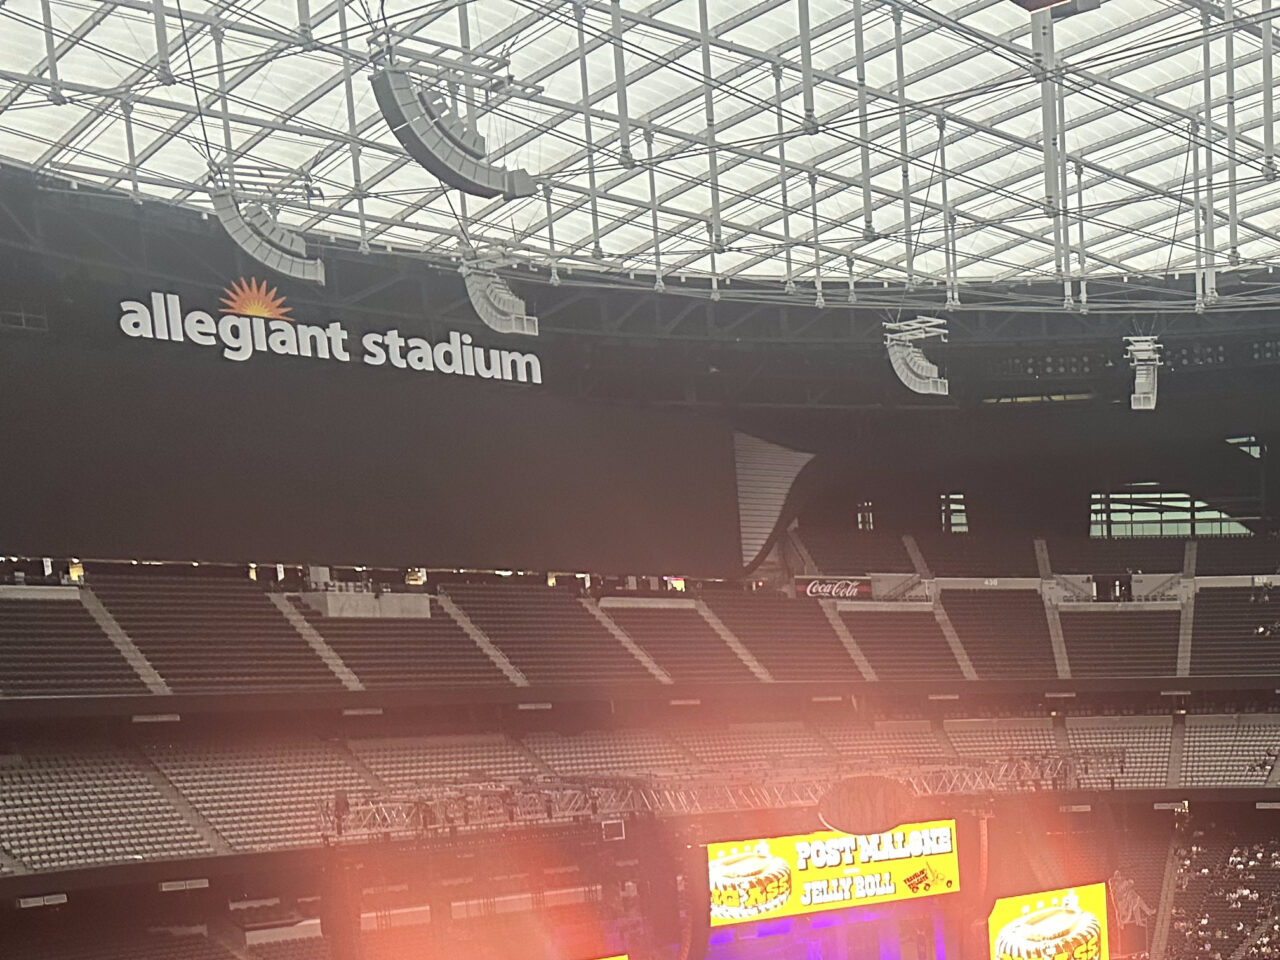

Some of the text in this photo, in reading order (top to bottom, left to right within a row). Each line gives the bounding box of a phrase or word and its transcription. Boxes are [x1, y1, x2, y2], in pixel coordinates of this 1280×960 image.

[119, 291, 543, 385] allegiant stadium
[795, 827, 953, 871] POST MALONE
[800, 872, 896, 906] JELLY ROLL
